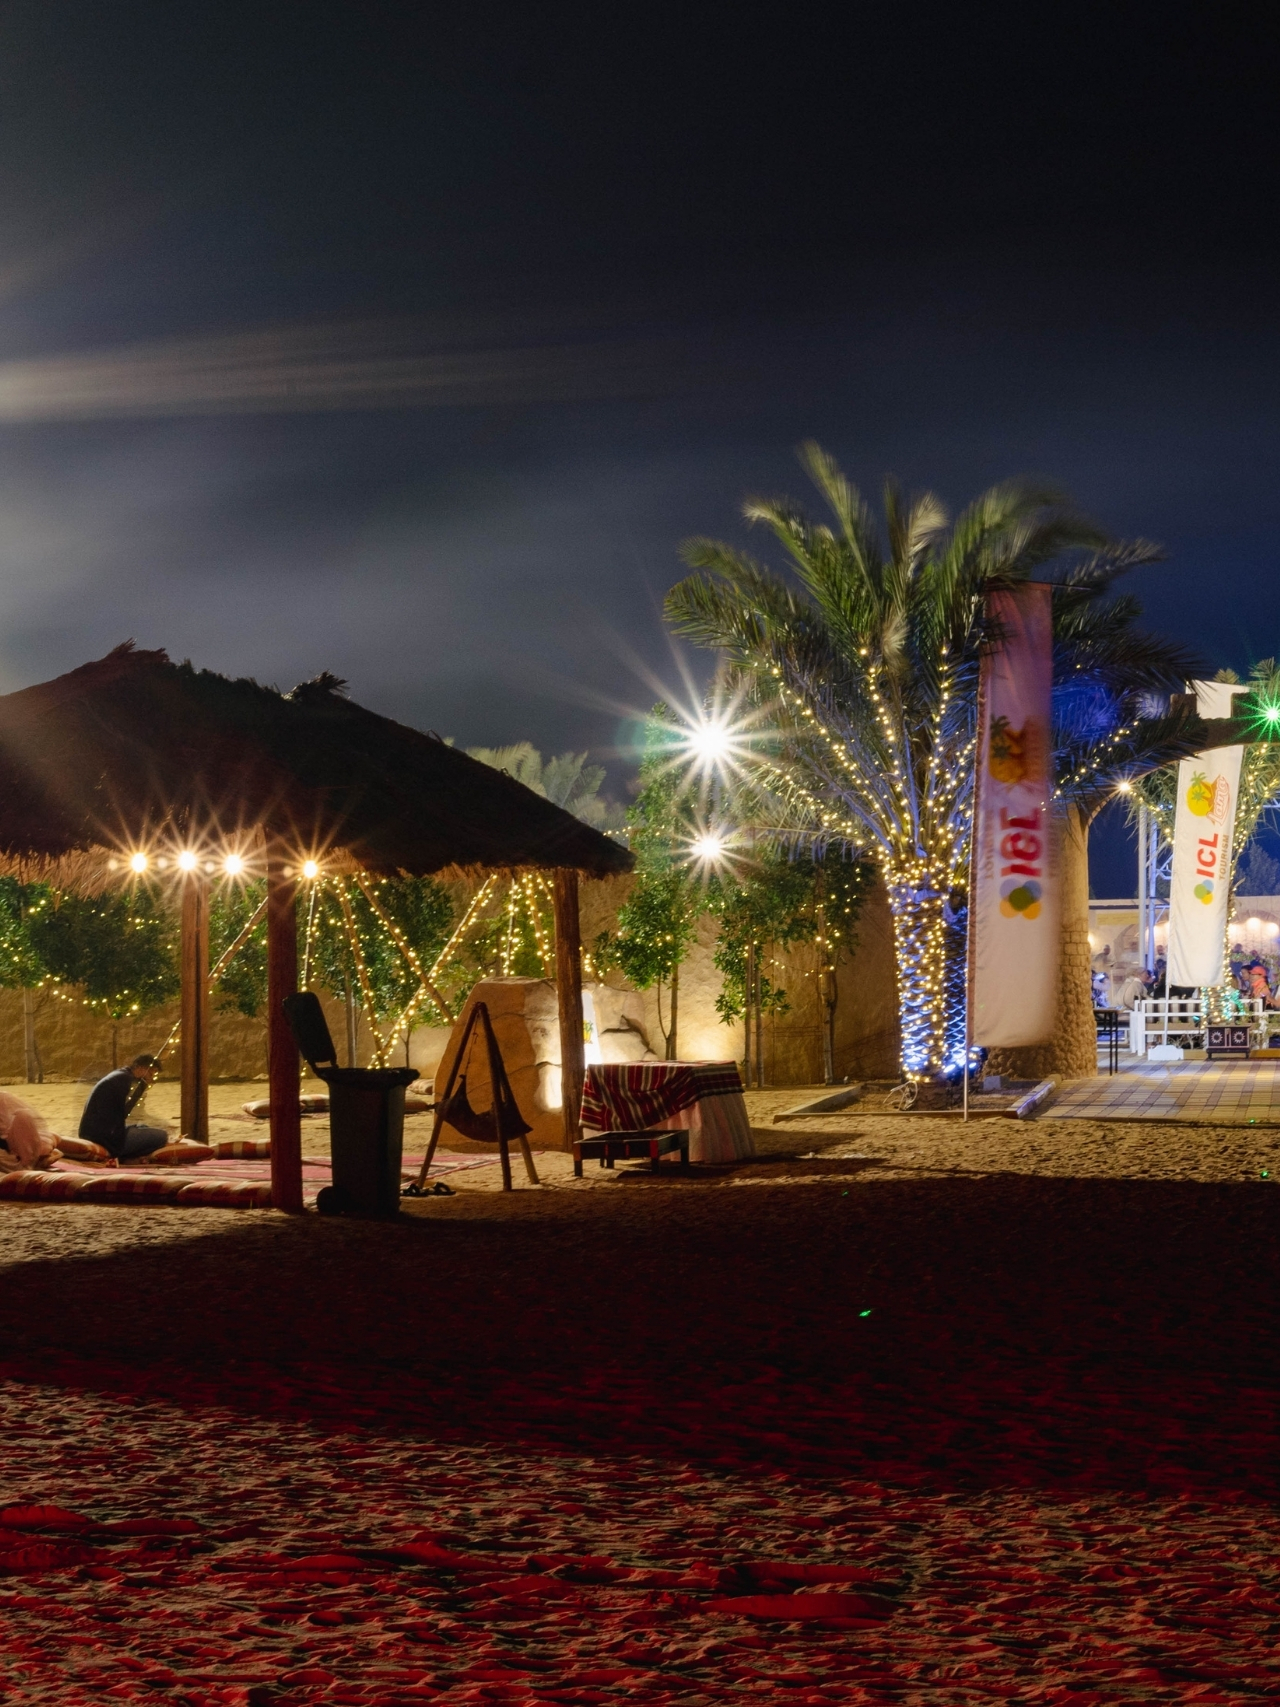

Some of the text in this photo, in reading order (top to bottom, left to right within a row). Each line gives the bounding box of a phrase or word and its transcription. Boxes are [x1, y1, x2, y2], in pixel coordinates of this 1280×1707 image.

[1206, 775, 1230, 826] Lama
[1000, 806, 1043, 877] ICL
[1196, 833, 1219, 878] ICL
[1219, 834, 1230, 880] TOURISM
